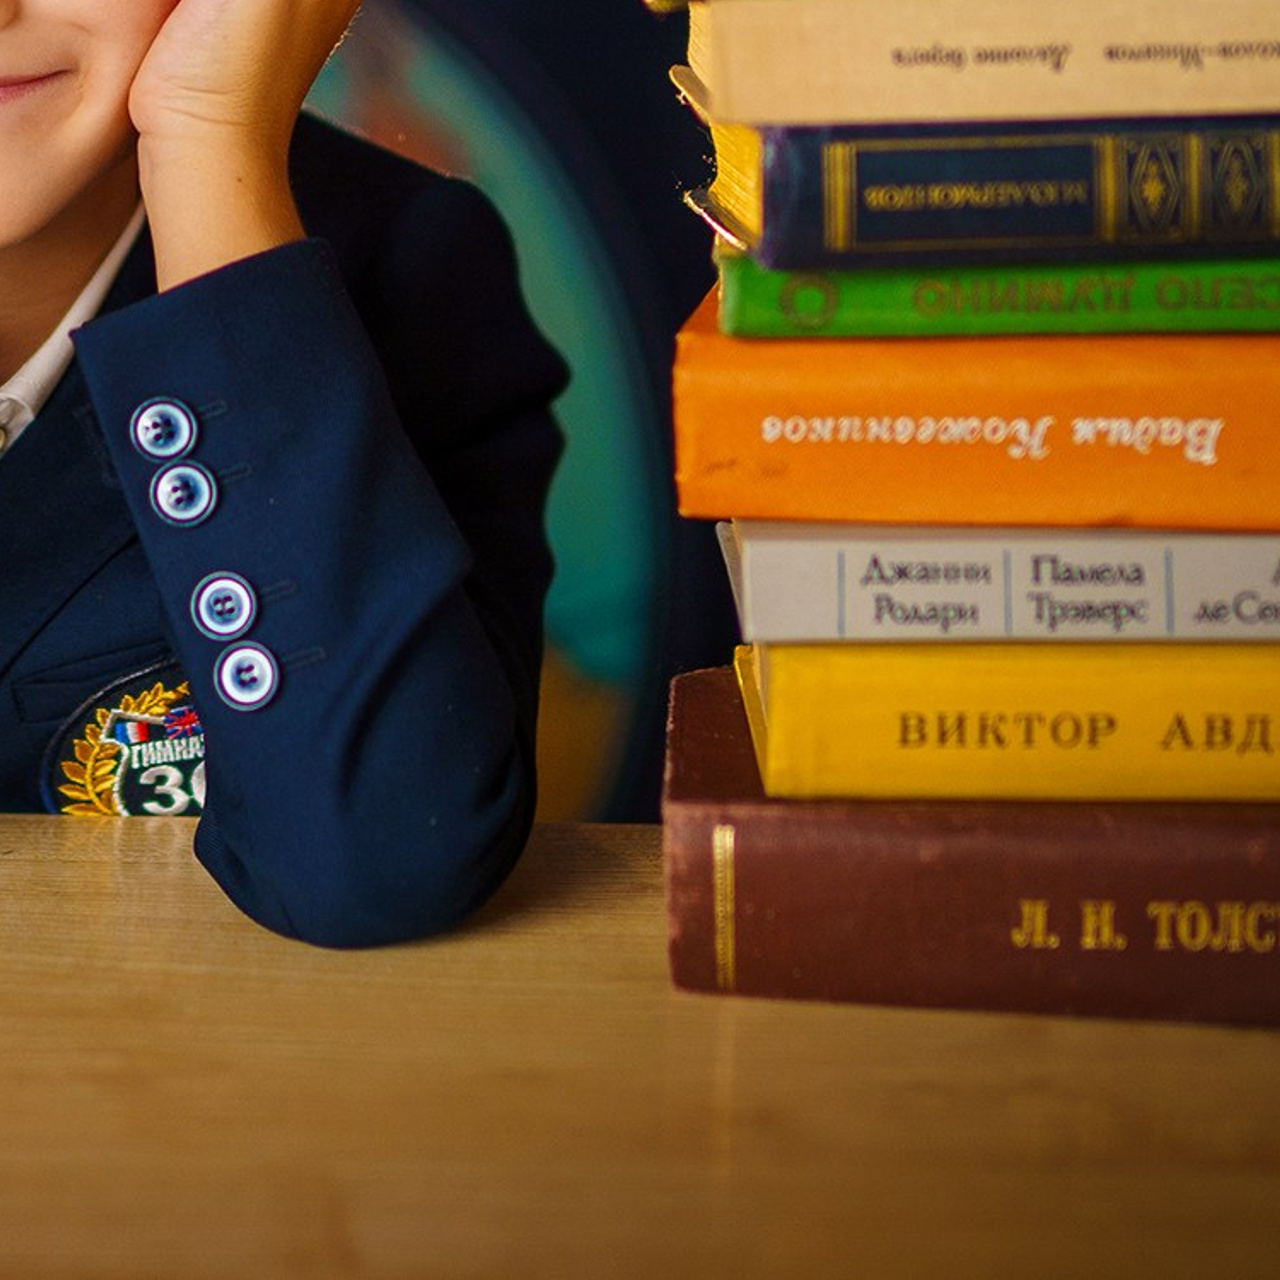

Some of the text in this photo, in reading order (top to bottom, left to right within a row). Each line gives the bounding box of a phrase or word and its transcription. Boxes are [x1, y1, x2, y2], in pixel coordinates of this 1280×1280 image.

[761, 415, 1224, 466] Вадим Кожевников
[860, 553, 991, 586] Джанни
[1031, 555, 1144, 586] Памела
[874, 593, 978, 632] Родари
[130, 734, 206, 769] ГИМНА
[895, 711, 1275, 758] ВИКТОР АВД
[1010, 898, 1277, 953] Л. Н. ТОЛС
